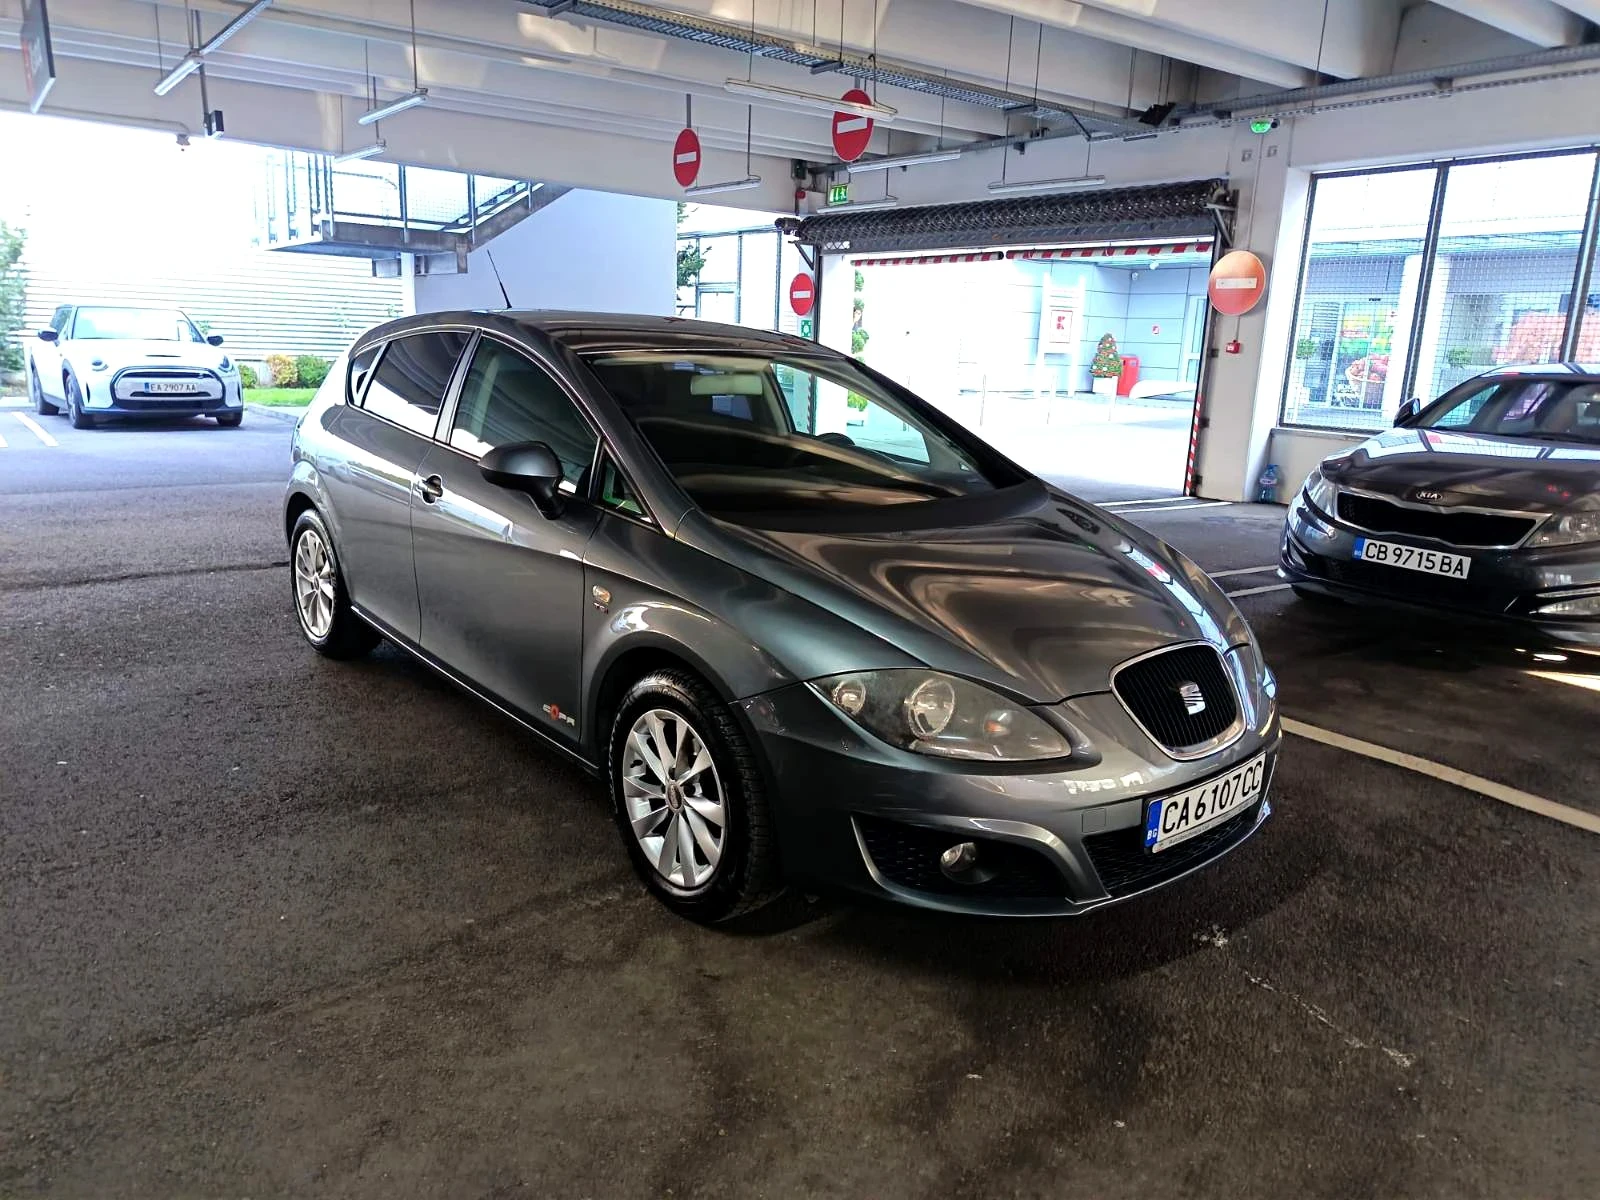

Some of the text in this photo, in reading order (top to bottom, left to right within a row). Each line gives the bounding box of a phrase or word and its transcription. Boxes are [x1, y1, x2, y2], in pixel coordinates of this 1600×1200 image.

[1365, 542, 1464, 576] CB 9715 BA
[1163, 797, 1190, 834] CA
[1195, 773, 1241, 820] 6107
[1242, 761, 1262, 797] CC
[1147, 829, 1158, 840] BG
